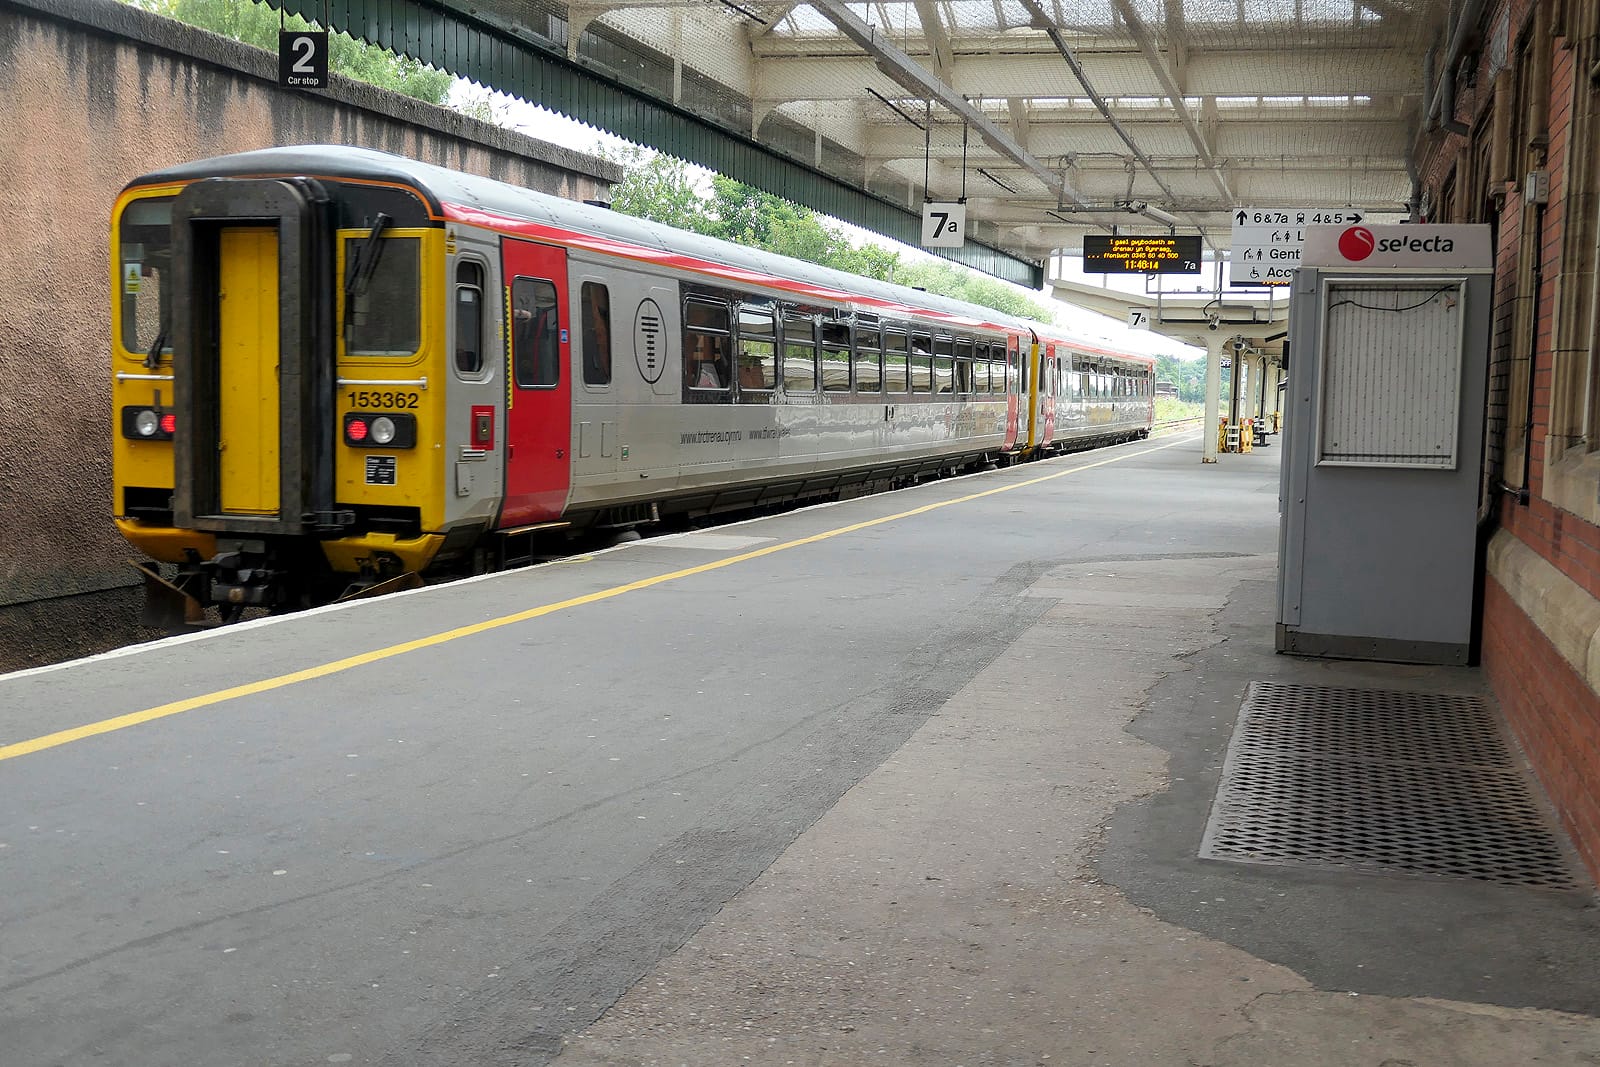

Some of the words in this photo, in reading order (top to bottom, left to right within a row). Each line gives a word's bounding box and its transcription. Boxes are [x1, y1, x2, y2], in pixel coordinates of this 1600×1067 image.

[292, 36, 315, 72] 2
[287, 76, 301, 85] Car
[302, 76, 319, 86] stop
[930, 212, 957, 238] 7a
[1269, 248, 1301, 260] Gent
[1184, 261, 1196, 269] 7a
[1131, 312, 1146, 326] 7a
[347, 391, 419, 409] 153362
